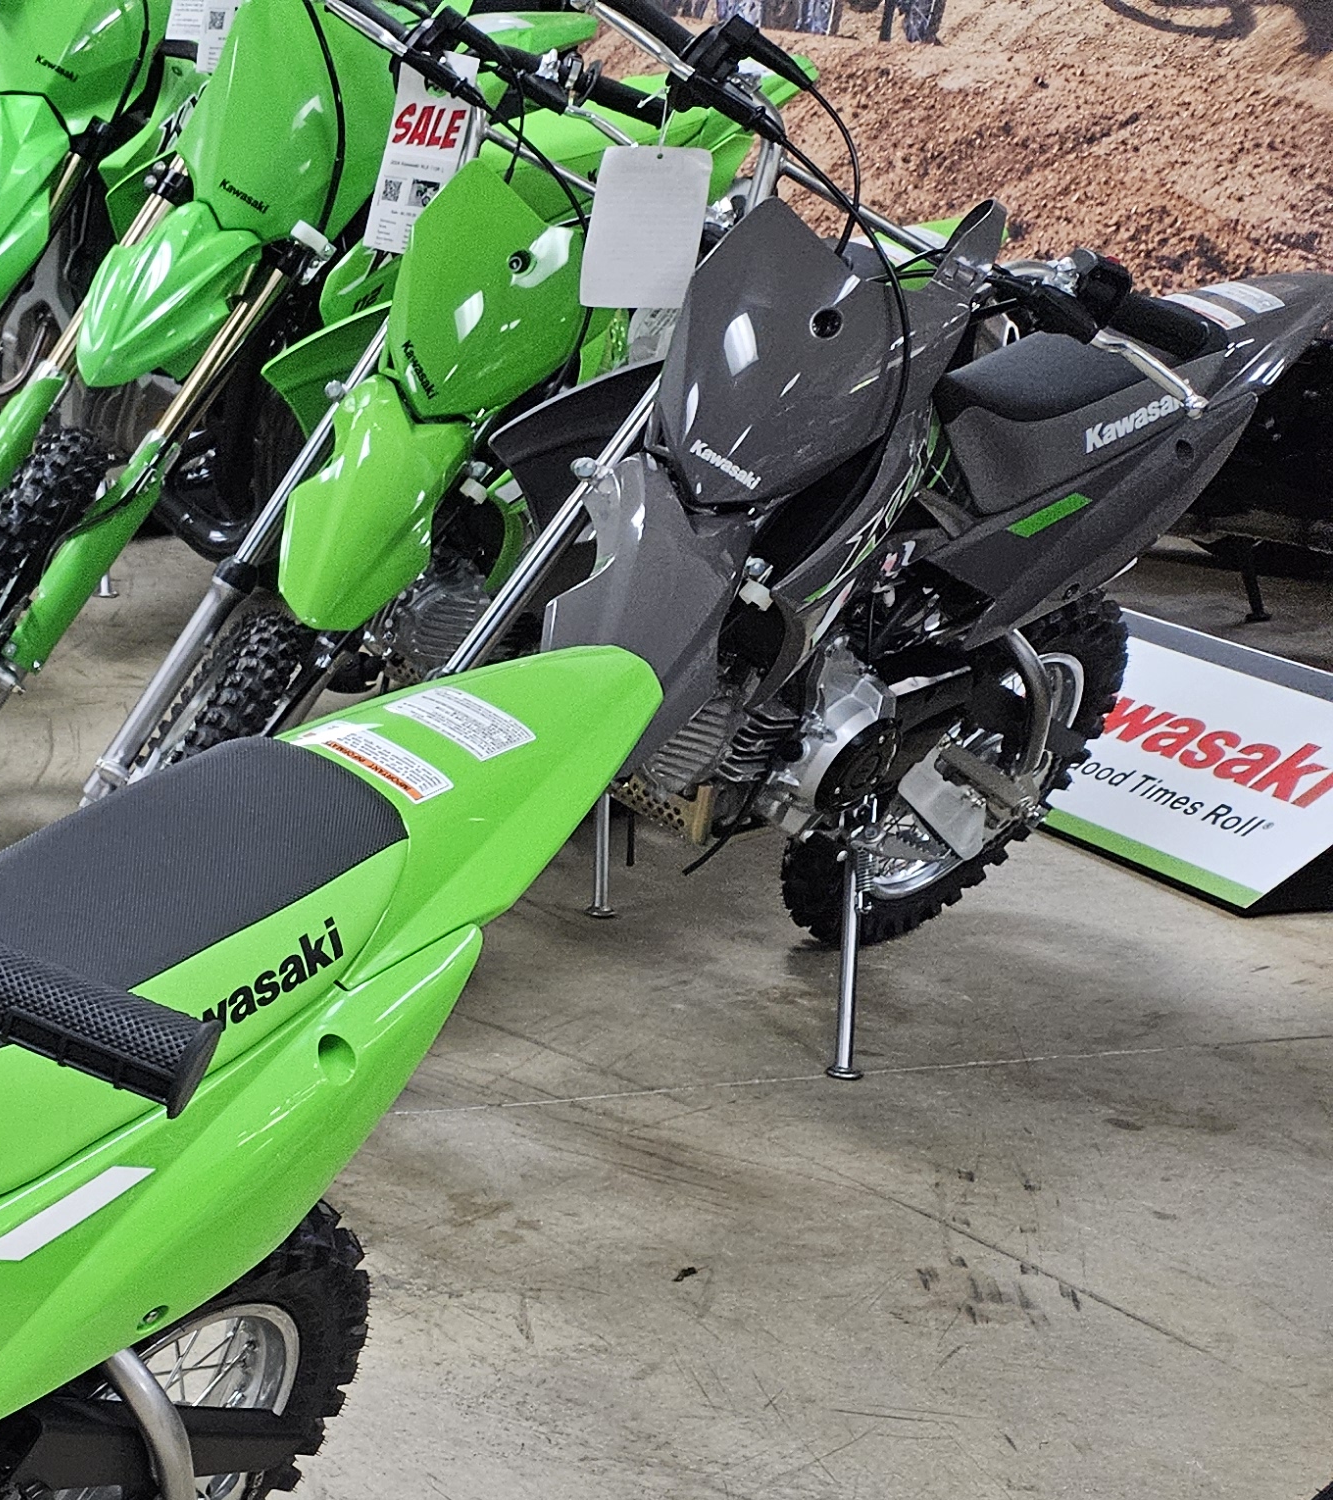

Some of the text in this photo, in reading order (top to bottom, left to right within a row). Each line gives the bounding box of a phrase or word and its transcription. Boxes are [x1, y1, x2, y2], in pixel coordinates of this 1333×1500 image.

[392, 103, 467, 149] SALE
[219, 178, 270, 214] Kawasaki
[402, 340, 440, 399] Kawasaki
[1084, 394, 1183, 454] Kawasa
[690, 439, 761, 490] Kawasaki
[1103, 693, 1333, 809] wasaki
[1071, 759, 1137, 787] ood
[1133, 773, 1204, 817] Times
[202, 916, 344, 1033] wasaki
